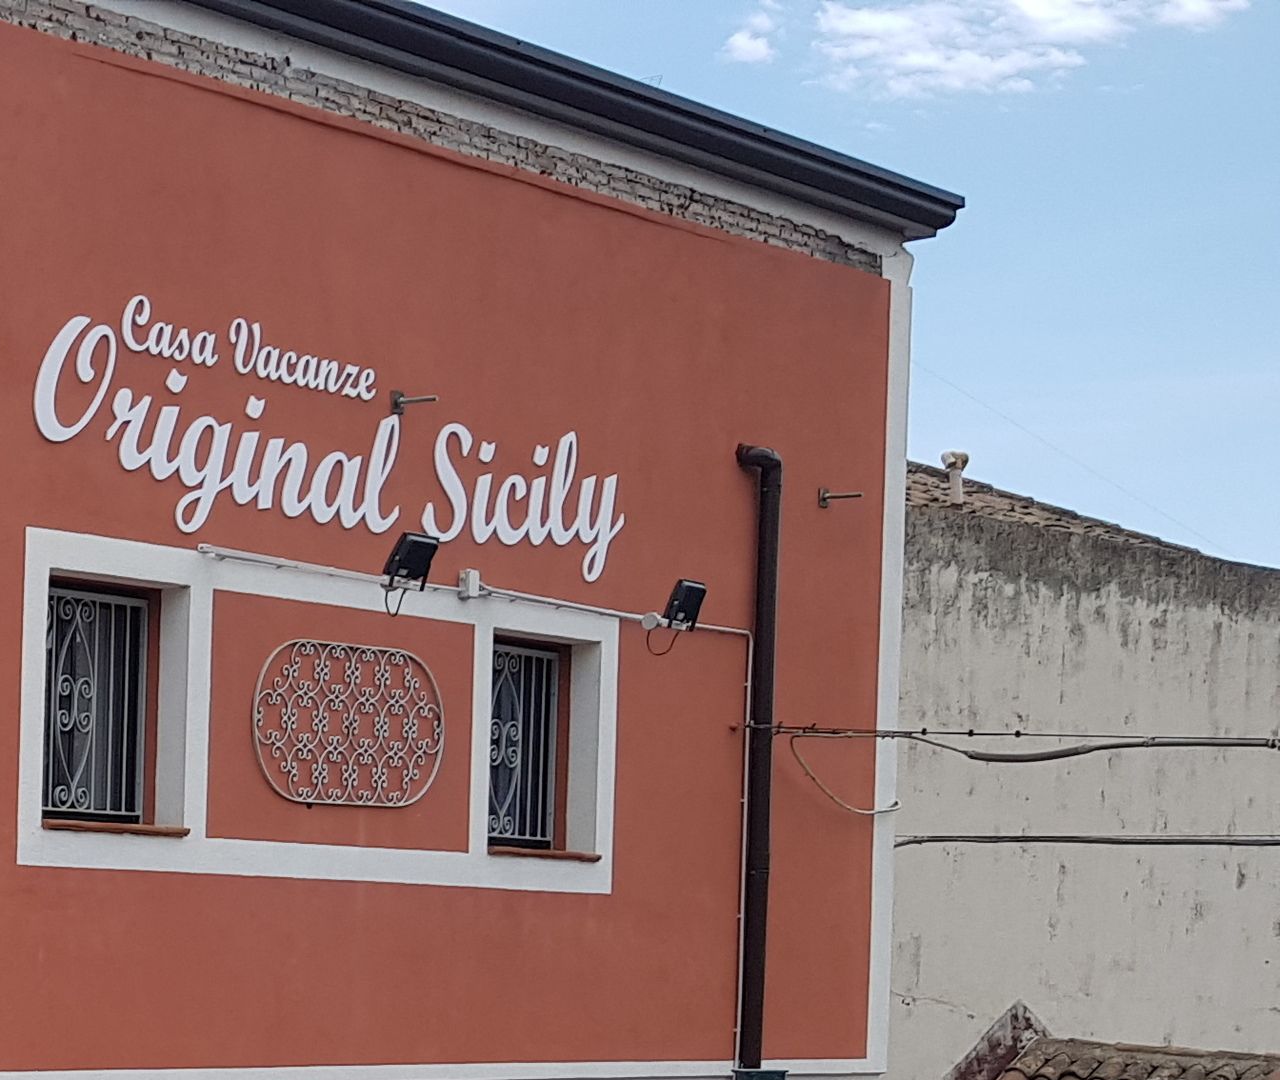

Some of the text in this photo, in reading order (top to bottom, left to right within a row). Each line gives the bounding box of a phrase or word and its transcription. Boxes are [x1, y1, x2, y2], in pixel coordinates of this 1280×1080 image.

[121, 295, 377, 400] Casa Vacanze
[34, 315, 625, 583] Original Sicily
